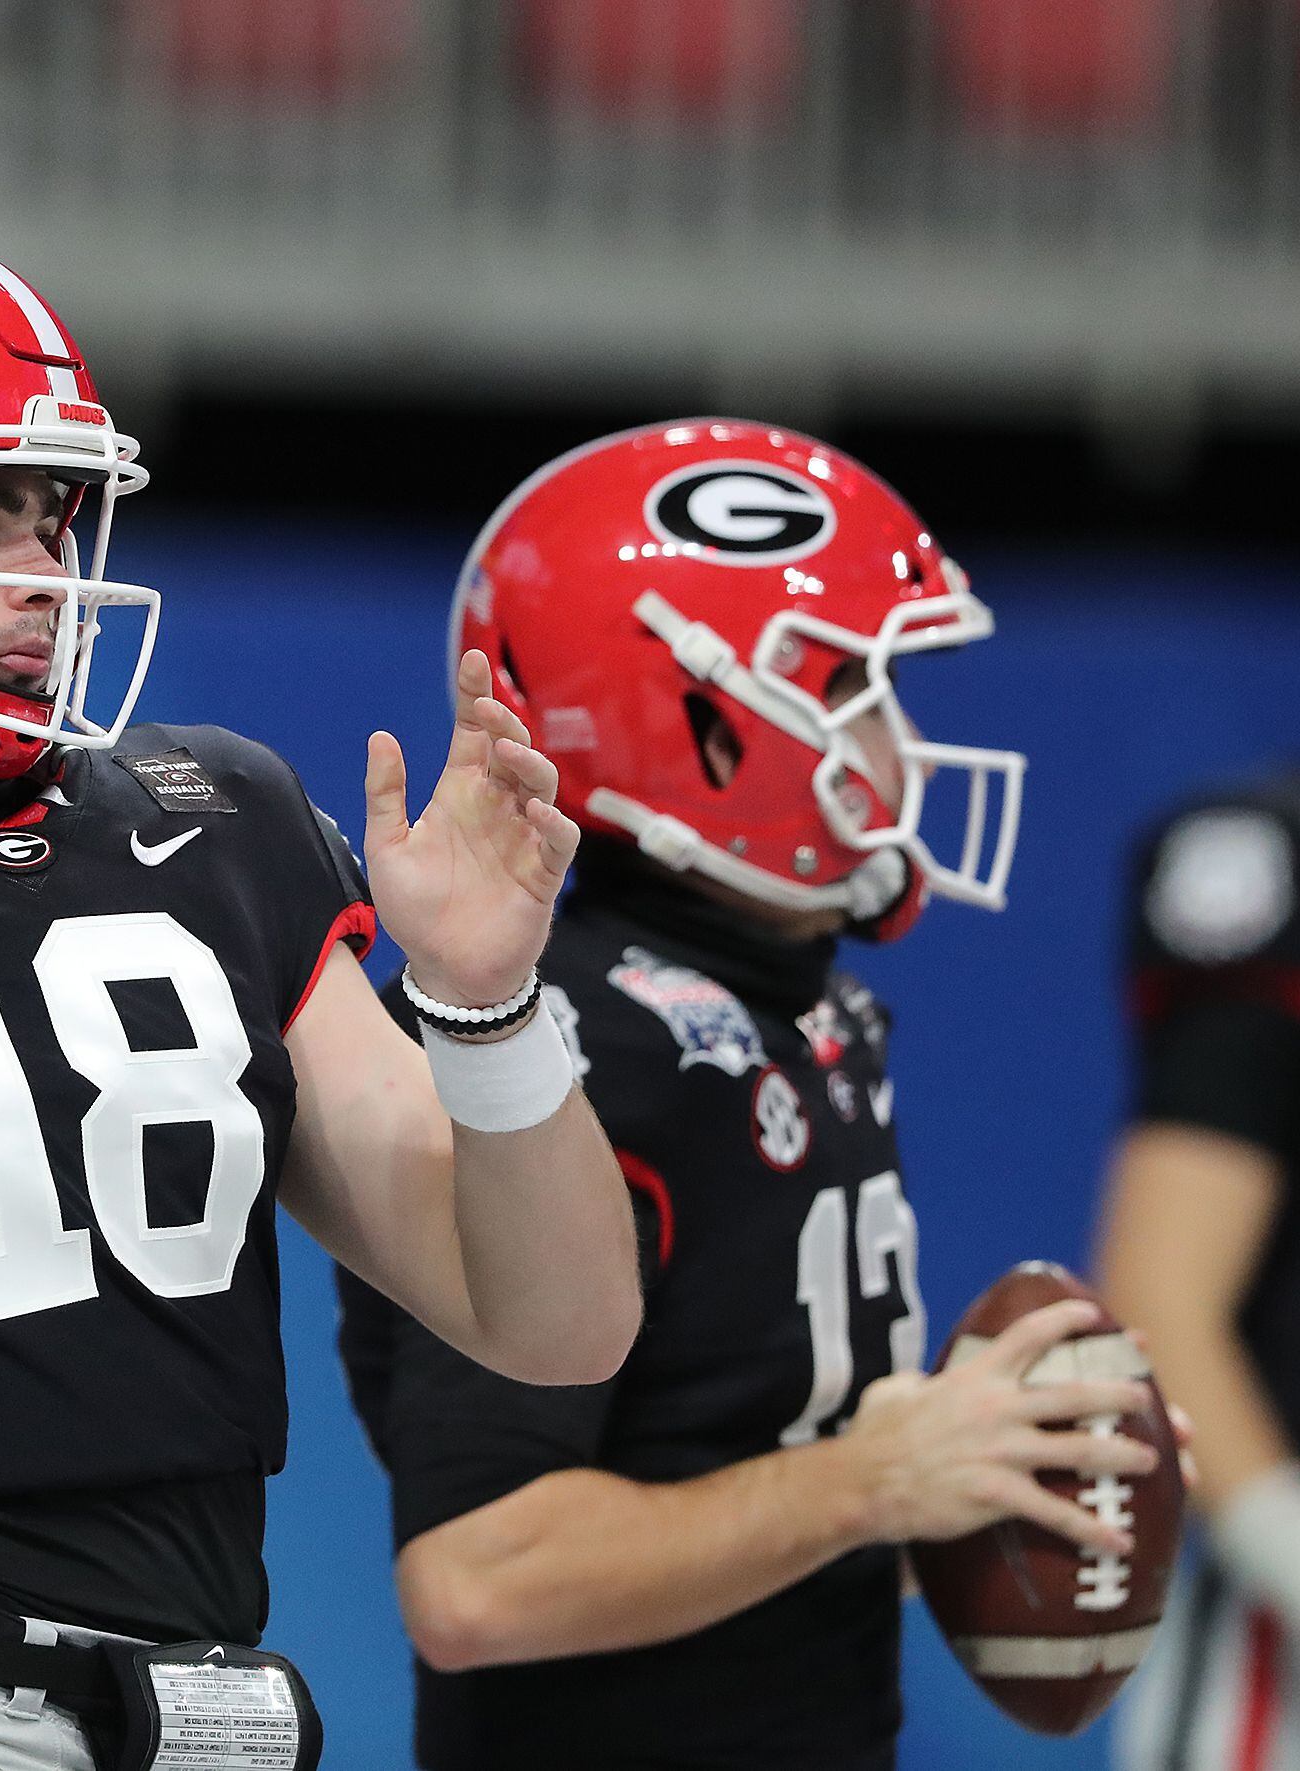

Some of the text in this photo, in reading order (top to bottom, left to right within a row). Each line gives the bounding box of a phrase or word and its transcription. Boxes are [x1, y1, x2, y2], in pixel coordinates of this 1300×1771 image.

[656, 470, 826, 553] G
[132, 761, 201, 774] TOGETHER
[155, 784, 215, 796] EQUALITY
